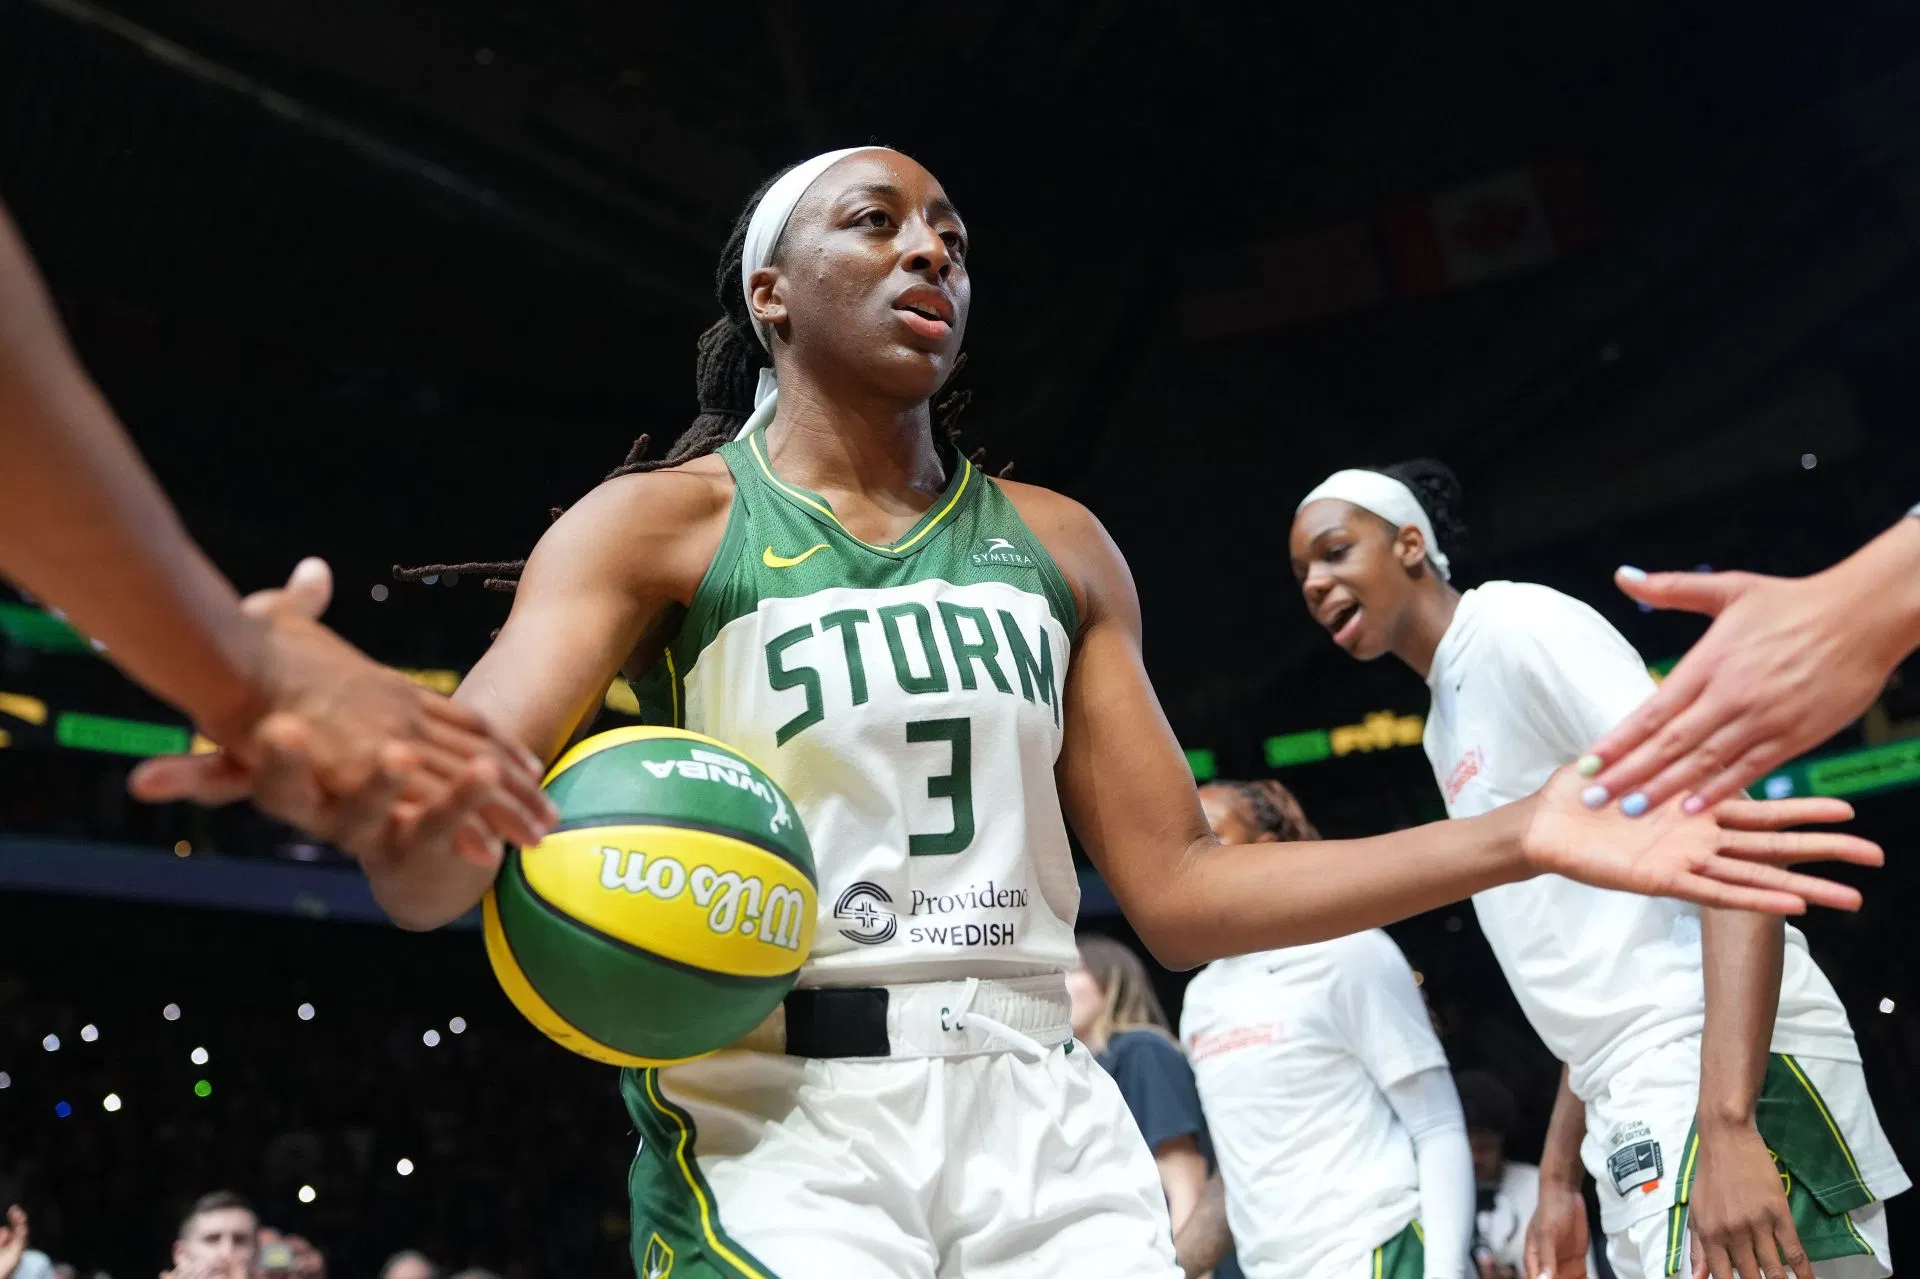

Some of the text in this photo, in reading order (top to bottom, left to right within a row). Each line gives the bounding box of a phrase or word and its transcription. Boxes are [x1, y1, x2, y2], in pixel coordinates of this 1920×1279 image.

[973, 554, 1032, 564] SYMETRA
[764, 600, 1060, 748] STORM
[641, 760, 773, 804] WNBA
[906, 717, 976, 857] 3
[601, 847, 804, 951] Wilson
[909, 881, 1028, 916] Providenc
[910, 923, 1015, 947] SWEDISH
